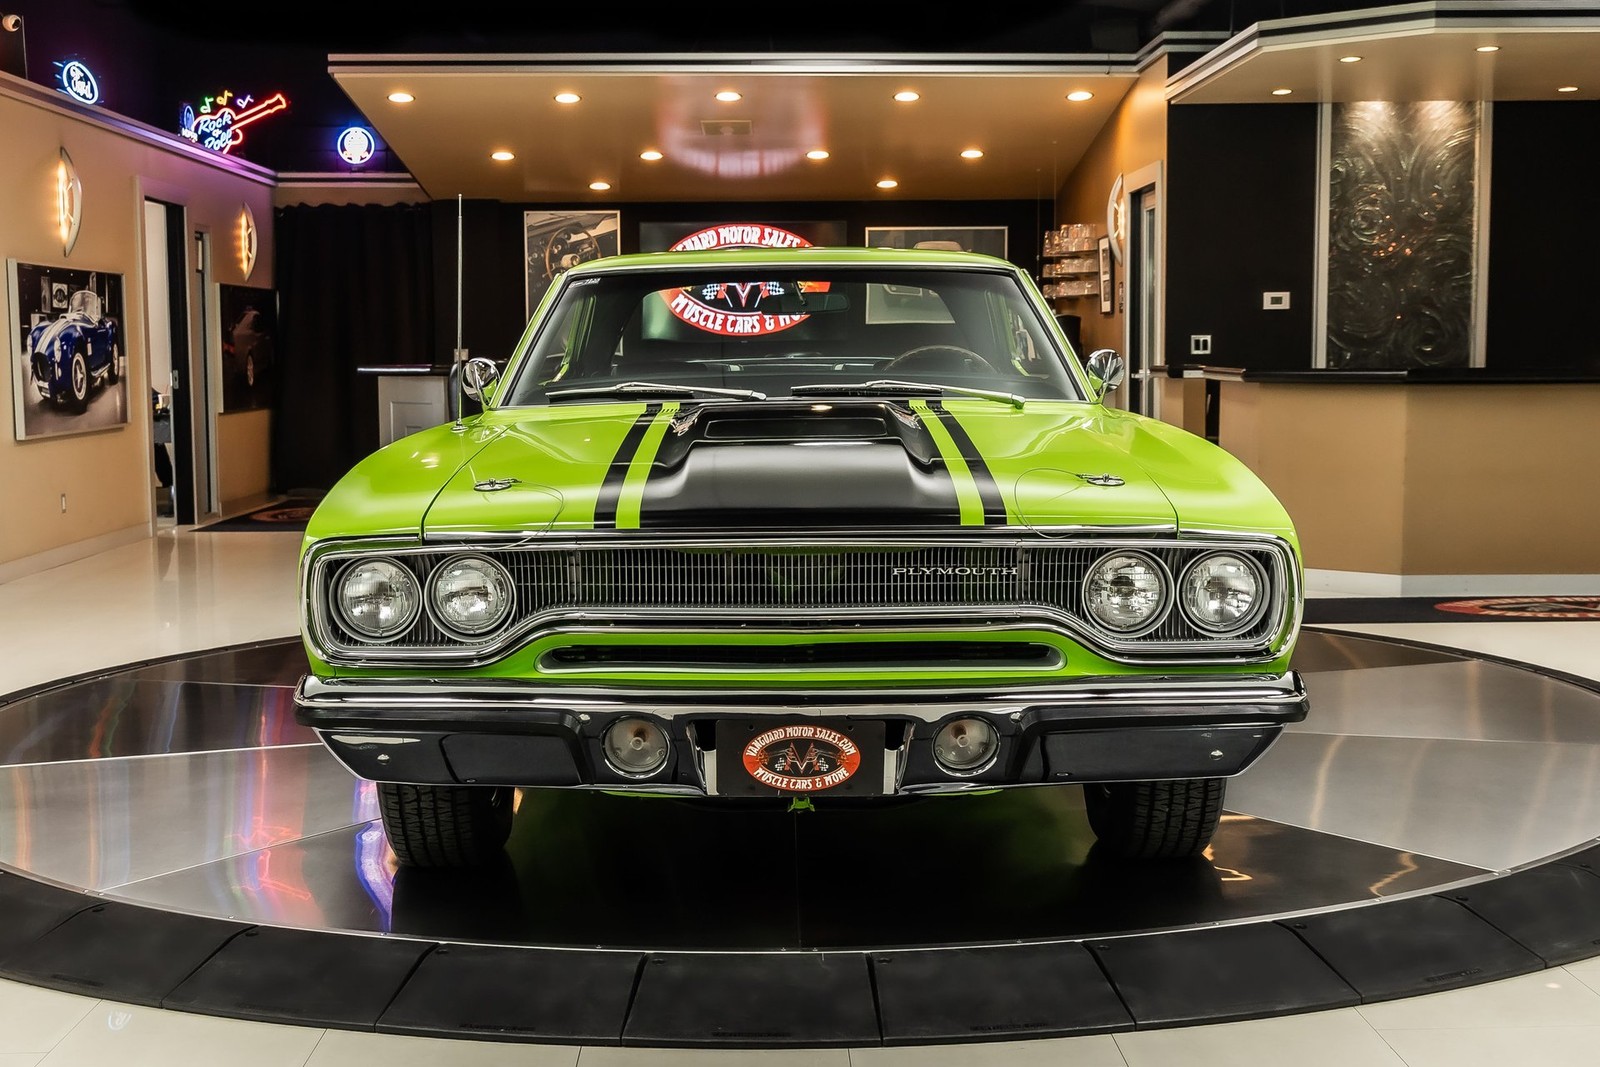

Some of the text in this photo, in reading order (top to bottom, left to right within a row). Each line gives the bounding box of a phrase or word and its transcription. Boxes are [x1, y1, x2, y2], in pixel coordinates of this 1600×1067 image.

[198, 111, 232, 135] Rock
[718, 226, 761, 245] MOTOR
[670, 293, 724, 331] MUSCLE
[726, 315, 761, 333] CARS
[763, 314, 775, 331] &
[892, 567, 1018, 575] PLYMOUTH
[746, 726, 857, 757] VANGUARD MOTOR SALES.COM
[753, 767, 850, 790] MUSCLE CARS & MORE
